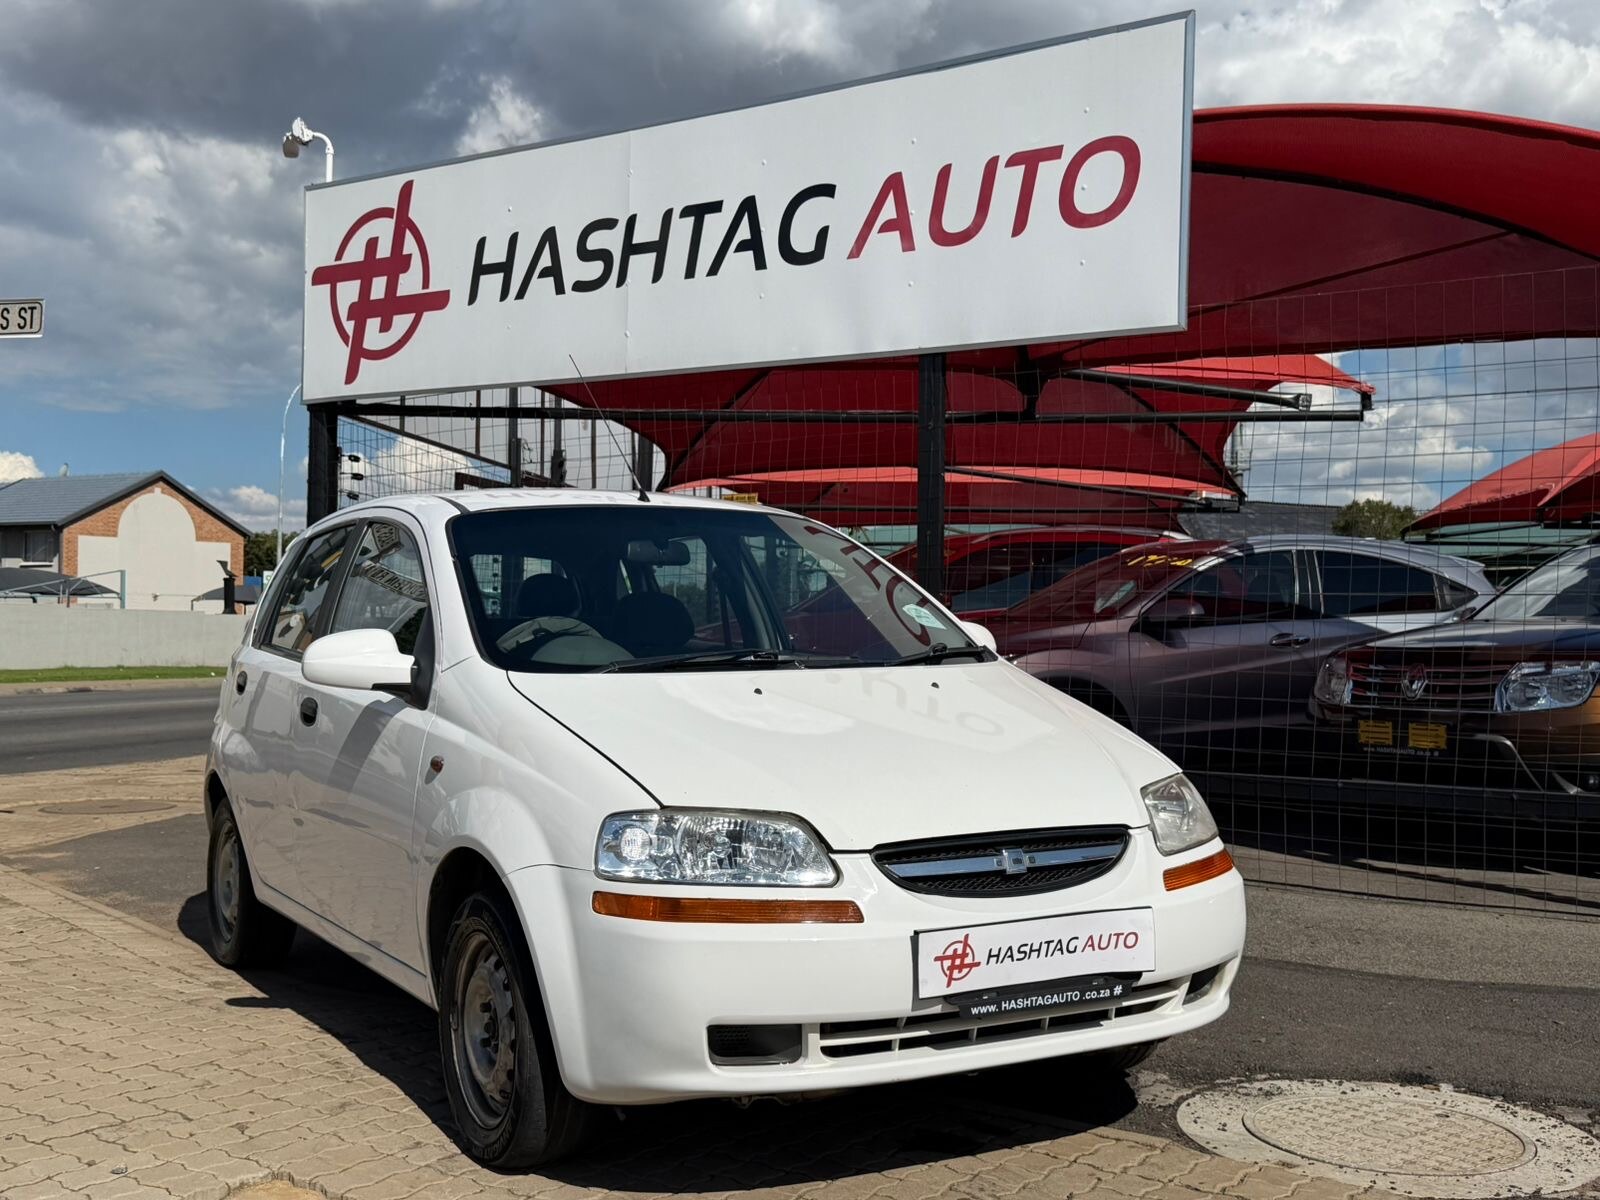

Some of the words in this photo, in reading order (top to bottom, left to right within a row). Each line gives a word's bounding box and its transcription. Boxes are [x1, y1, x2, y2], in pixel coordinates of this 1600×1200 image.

[467, 183, 837, 307] HASHTAG
[848, 135, 1141, 259] AUTO
[17, 306, 37, 330] ST
[986, 937, 1079, 965] HASHTAG
[1081, 931, 1139, 953] AUTO
[970, 1004, 999, 1016] www.
[1002, 991, 1080, 1011] HASHTAGAUTO
[1082, 988, 1111, 1001] .co.za
